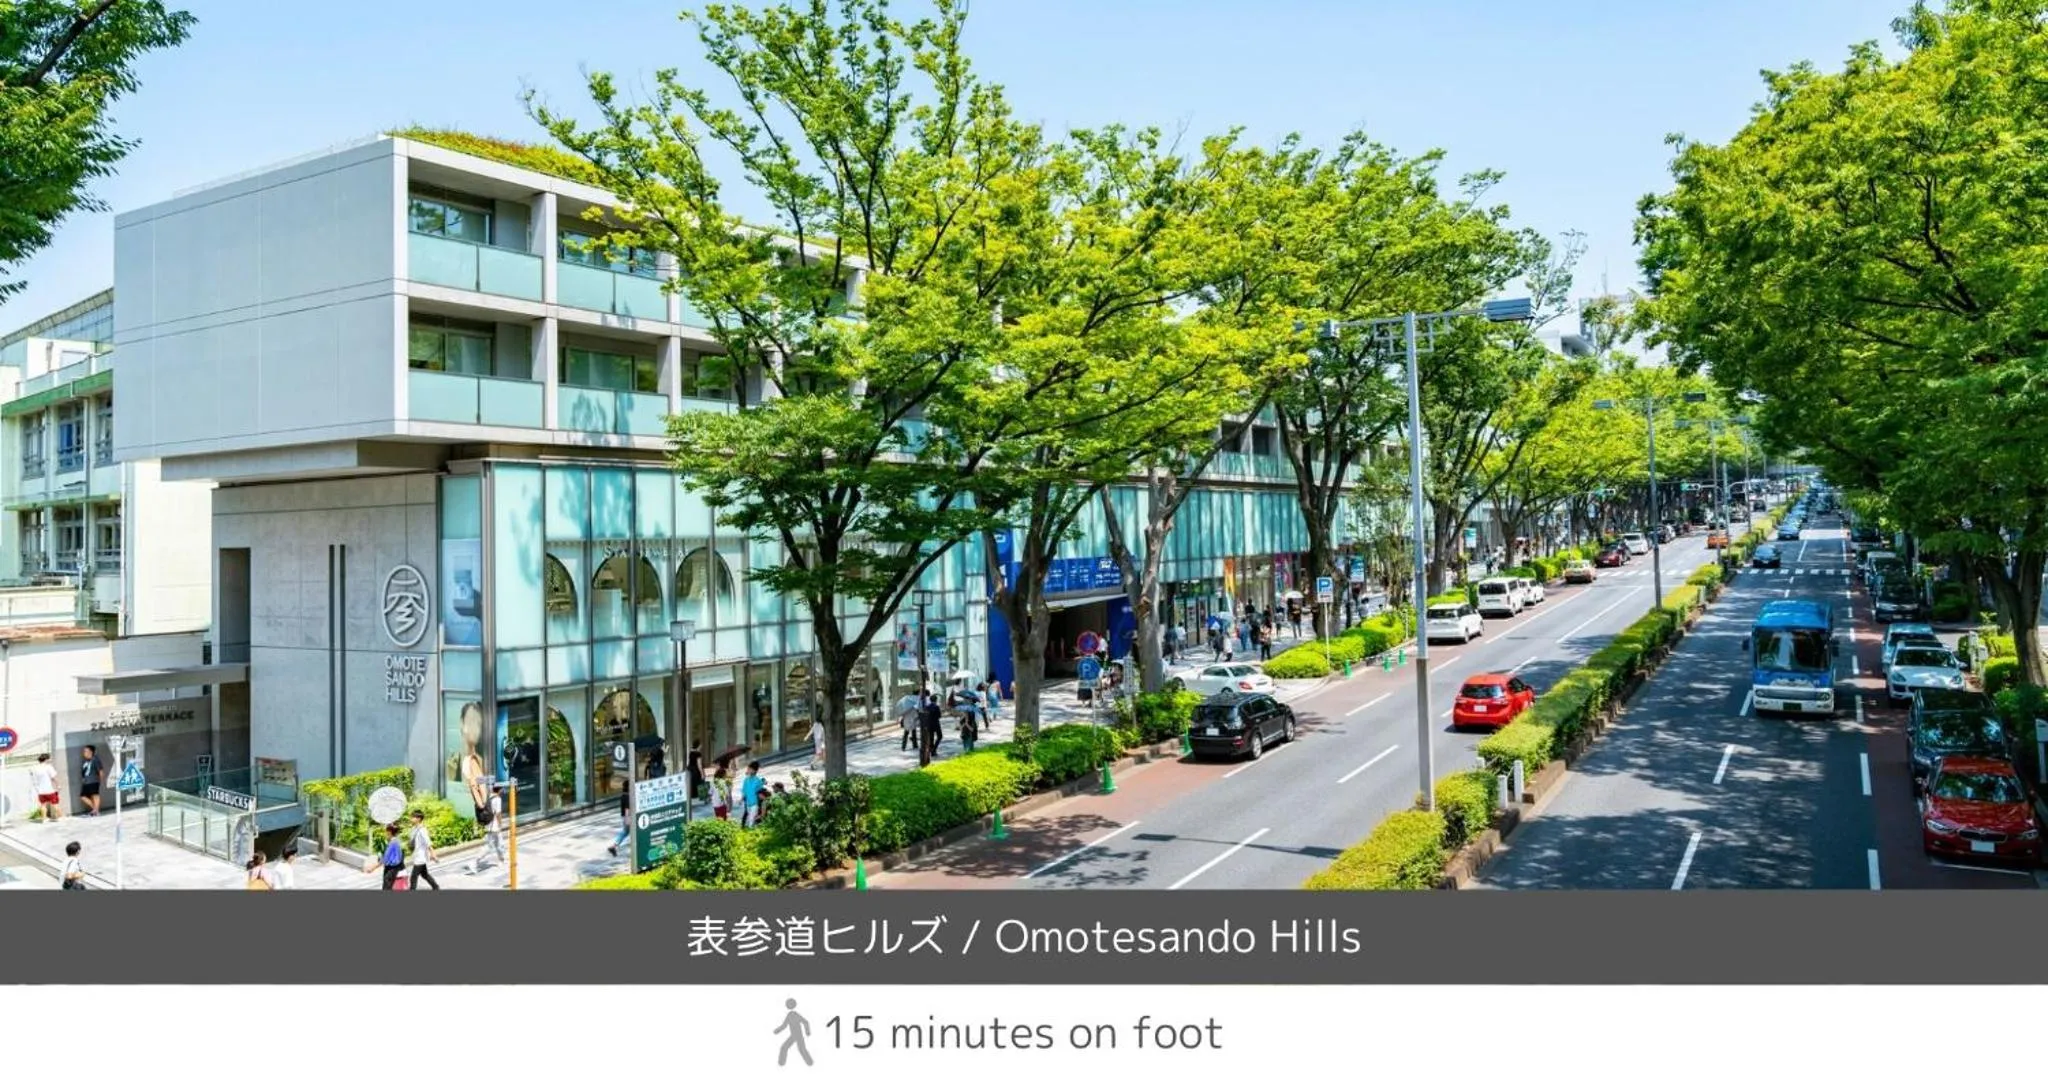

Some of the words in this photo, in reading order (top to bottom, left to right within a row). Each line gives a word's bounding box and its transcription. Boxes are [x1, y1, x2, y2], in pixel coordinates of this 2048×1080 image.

[384, 655, 425, 671] OMOTE
[385, 671, 425, 688] SANDO
[386, 687, 417, 703] HILLS
[143, 710, 195, 724] TERRACE
[132, 726, 156, 735] WEST
[207, 787, 249, 810] STARBUCKS
